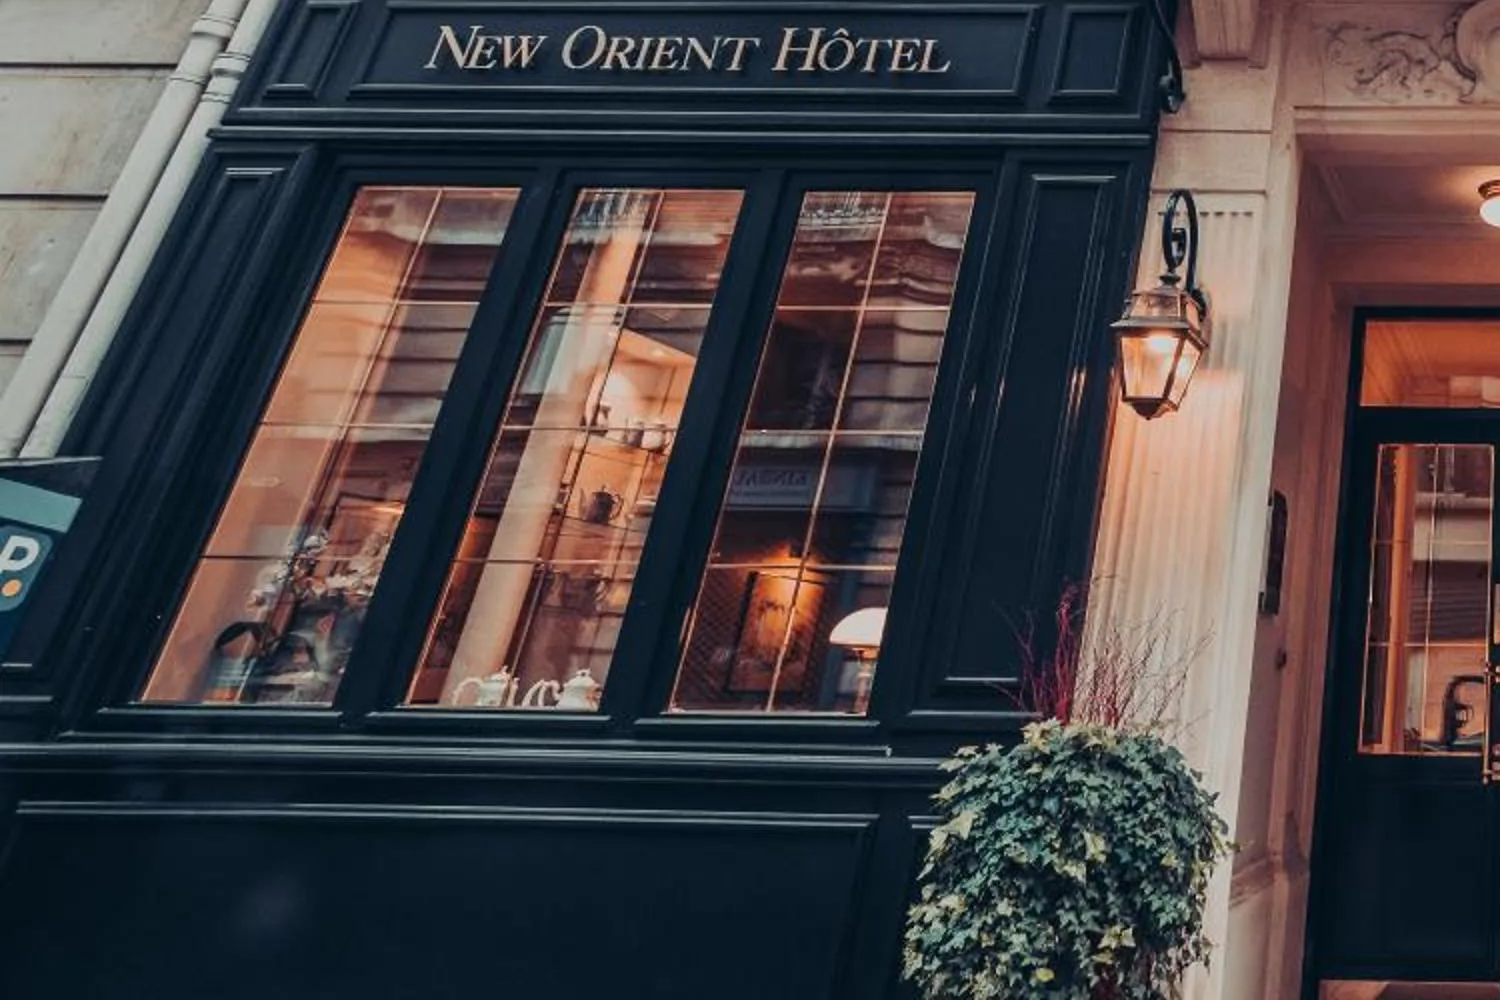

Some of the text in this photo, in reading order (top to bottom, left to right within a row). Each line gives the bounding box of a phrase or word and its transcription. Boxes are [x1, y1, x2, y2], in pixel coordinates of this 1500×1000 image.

[424, 25, 951, 74] NEW ORIENT HÔTEL
[0, 535, 40, 574] P
